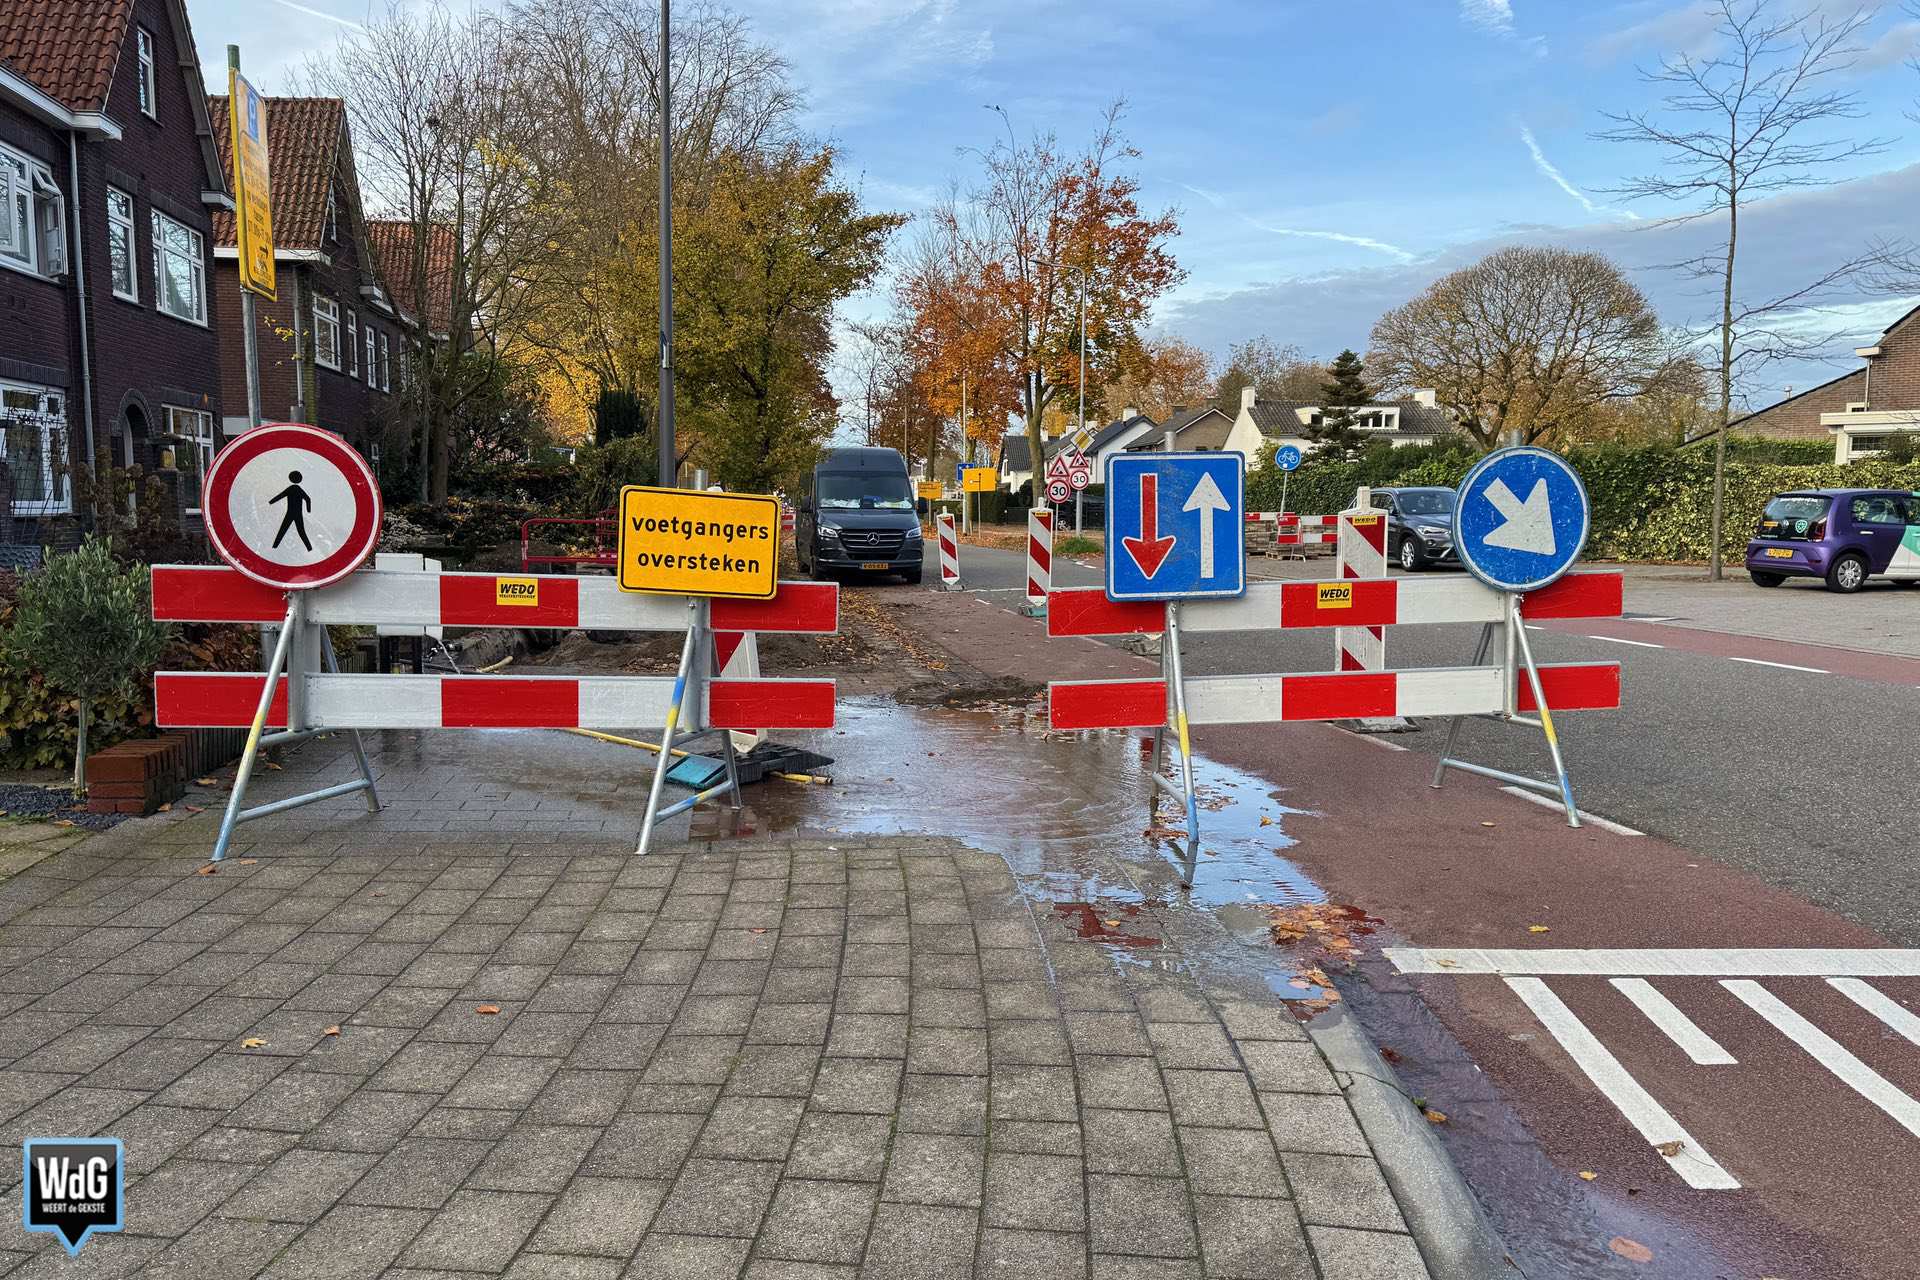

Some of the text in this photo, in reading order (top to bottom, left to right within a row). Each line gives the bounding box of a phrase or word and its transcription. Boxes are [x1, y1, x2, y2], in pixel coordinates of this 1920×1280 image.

[1073, 475, 1086, 483] 30
[1051, 486, 1067, 496] 30
[632, 516, 769, 543] voetgangers
[637, 552, 760, 573] oversteken
[500, 583, 536, 595] WEDO
[1320, 588, 1350, 599] WEDO
